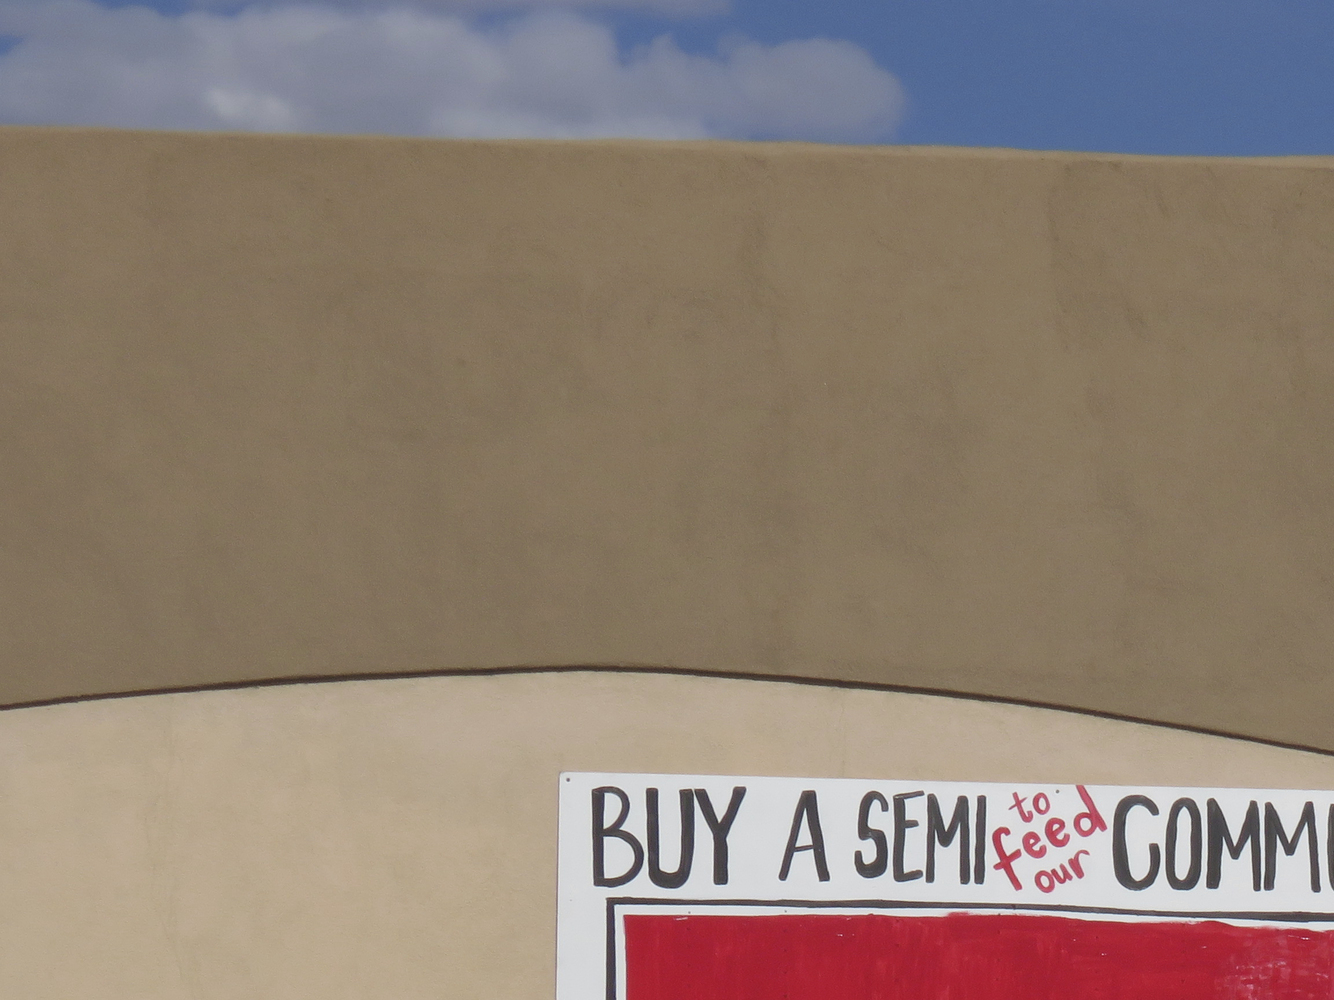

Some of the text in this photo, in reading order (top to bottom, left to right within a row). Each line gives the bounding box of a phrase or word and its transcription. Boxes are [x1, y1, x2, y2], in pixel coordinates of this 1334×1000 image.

[591, 786, 987, 889] BUY A SEMI
[992, 785, 1107, 891] feed
[1008, 792, 1050, 823] to
[1035, 850, 1090, 893] our
